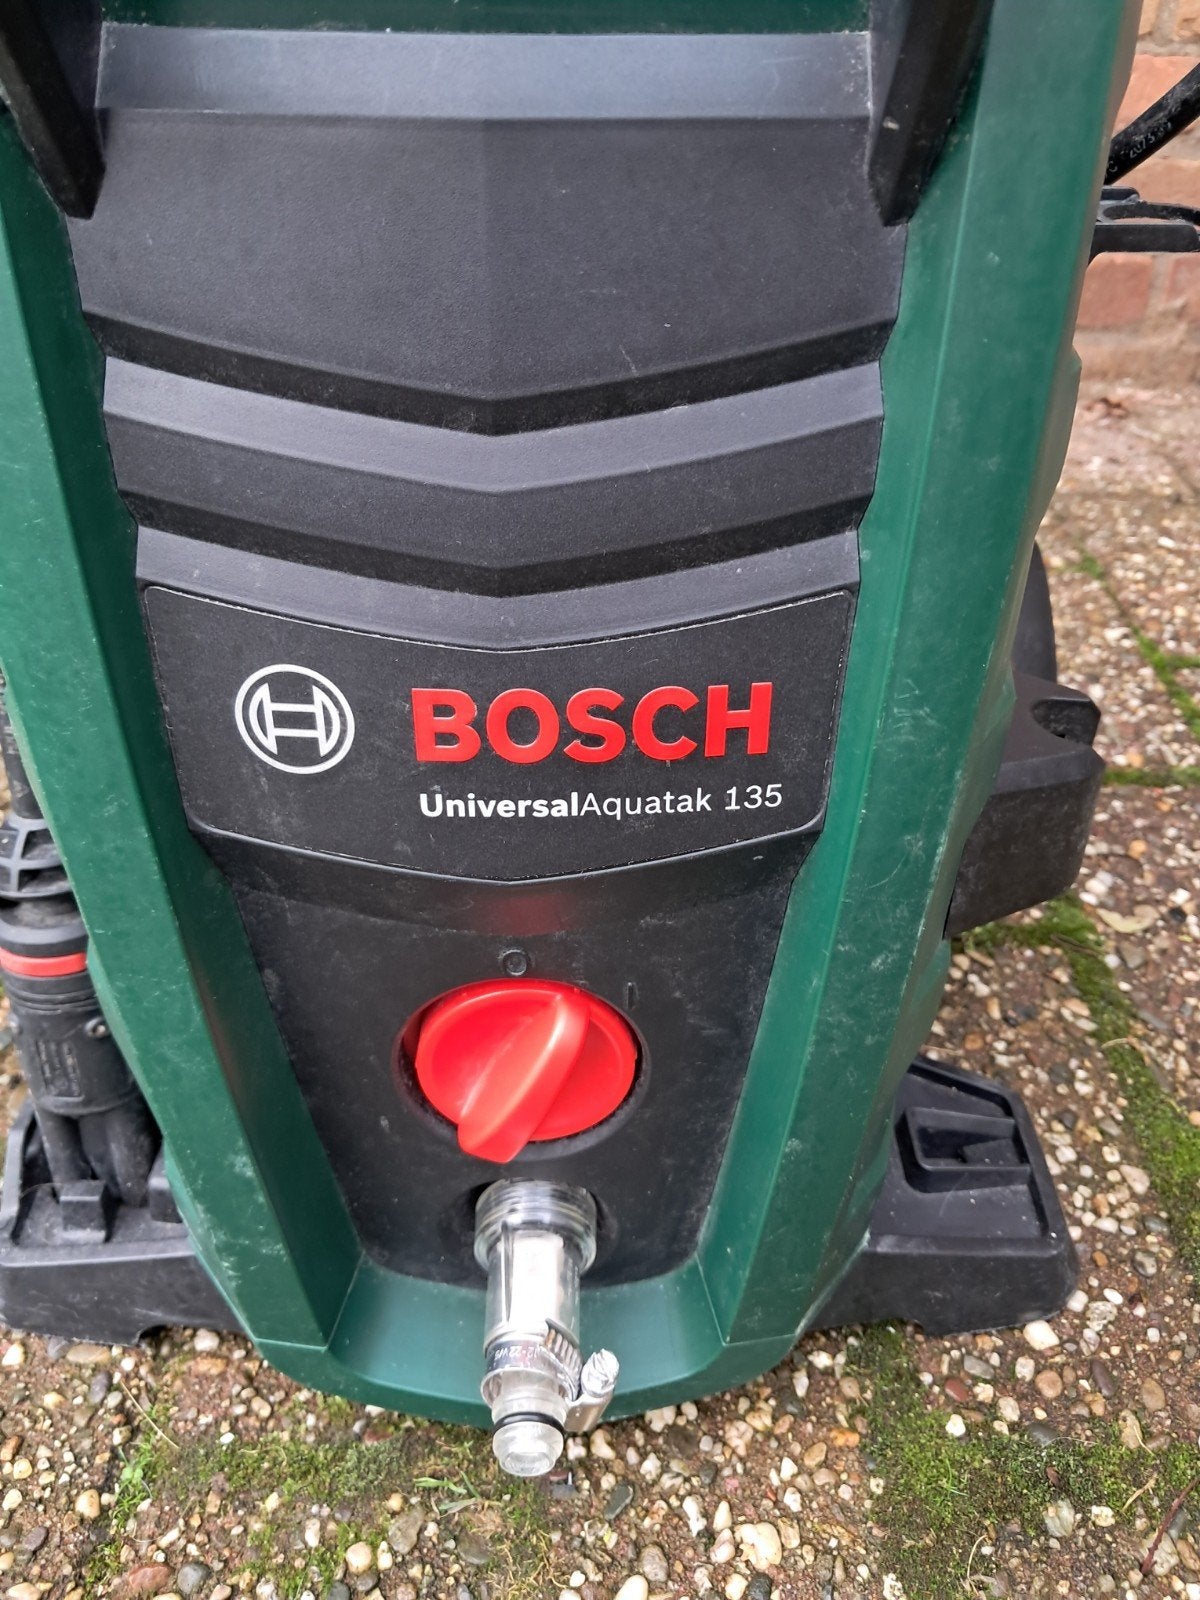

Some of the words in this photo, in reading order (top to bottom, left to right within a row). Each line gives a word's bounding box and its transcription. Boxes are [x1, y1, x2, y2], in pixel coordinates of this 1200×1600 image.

[411, 682, 773, 763] BOSCH
[419, 787, 712, 820] UniversalAquatak
[725, 783, 783, 810] 135
